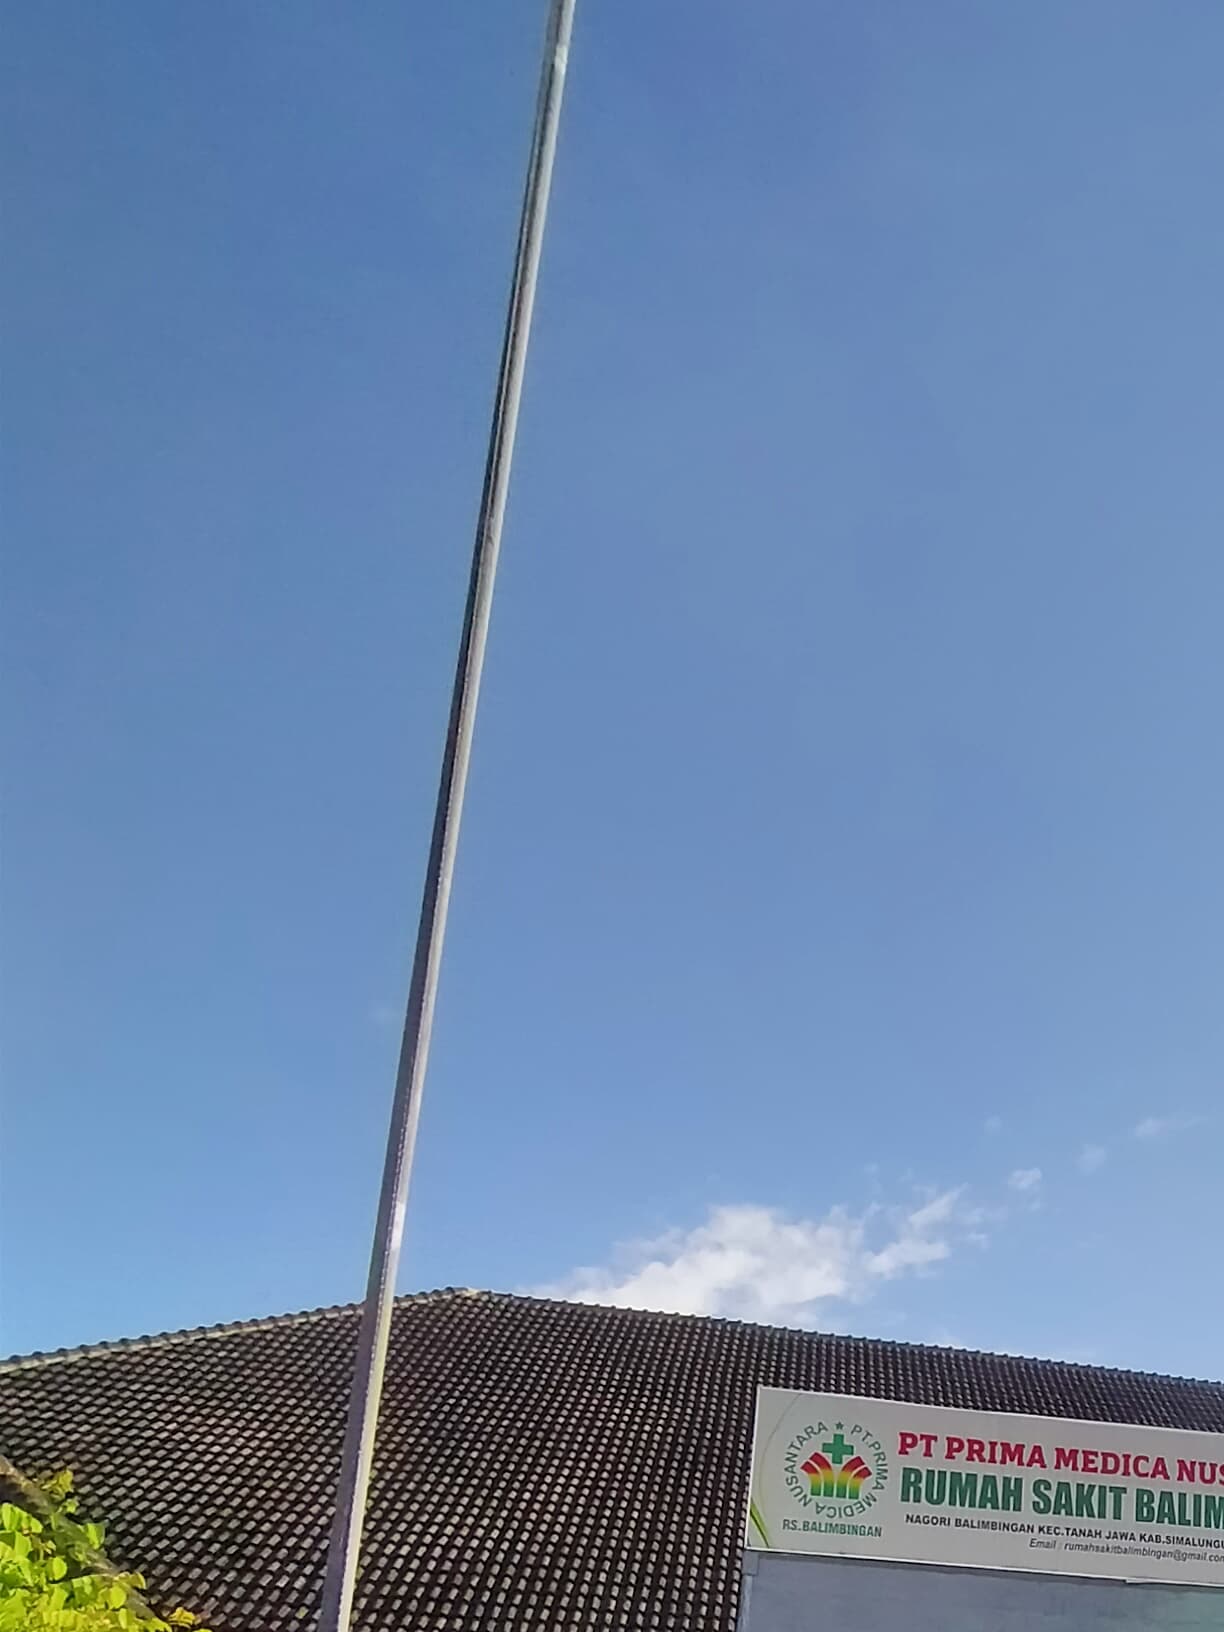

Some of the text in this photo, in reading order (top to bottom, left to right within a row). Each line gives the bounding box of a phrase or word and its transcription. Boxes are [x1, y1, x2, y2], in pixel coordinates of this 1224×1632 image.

[784, 1421, 828, 1507] NUSANTARA
[898, 1431, 938, 1457] PT
[944, 1436, 1047, 1468] PRIMA
[1053, 1447, 1170, 1481] MEDICA
[815, 1492, 877, 1518] MEDICA
[900, 1467, 1023, 1512] RUMAH
[1032, 1479, 1127, 1520] SAKIT
[905, 1513, 951, 1527] NAGORI
[954, 1518, 1035, 1534] BALIMBINGAN
[1105, 1530, 1136, 1542] JAWA
[1029, 1537, 1057, 1549] Email
